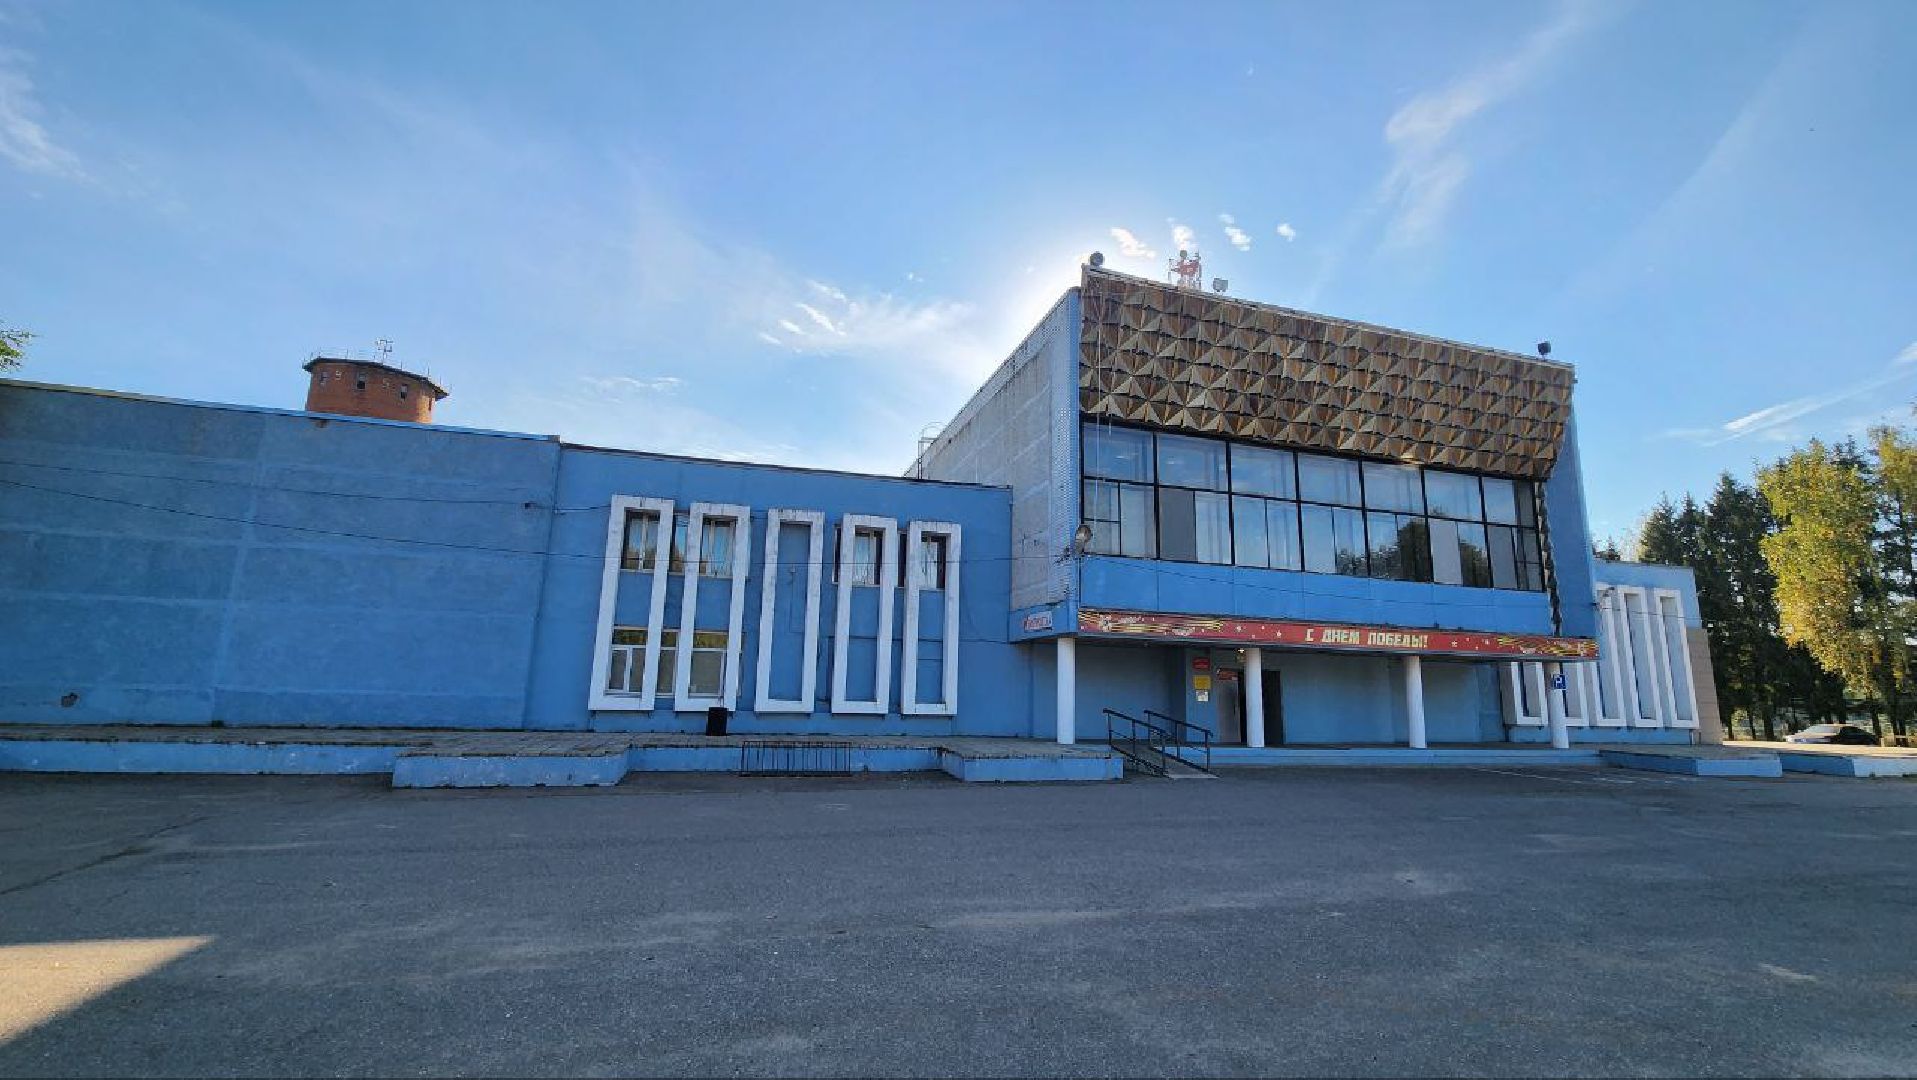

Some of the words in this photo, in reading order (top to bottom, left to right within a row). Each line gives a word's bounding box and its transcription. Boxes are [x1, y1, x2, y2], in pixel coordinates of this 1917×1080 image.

[1305, 629, 1314, 642] С
[1321, 629, 1360, 645] ДНЕМ
[1367, 632, 1428, 648] ПОБЕДЫ!
